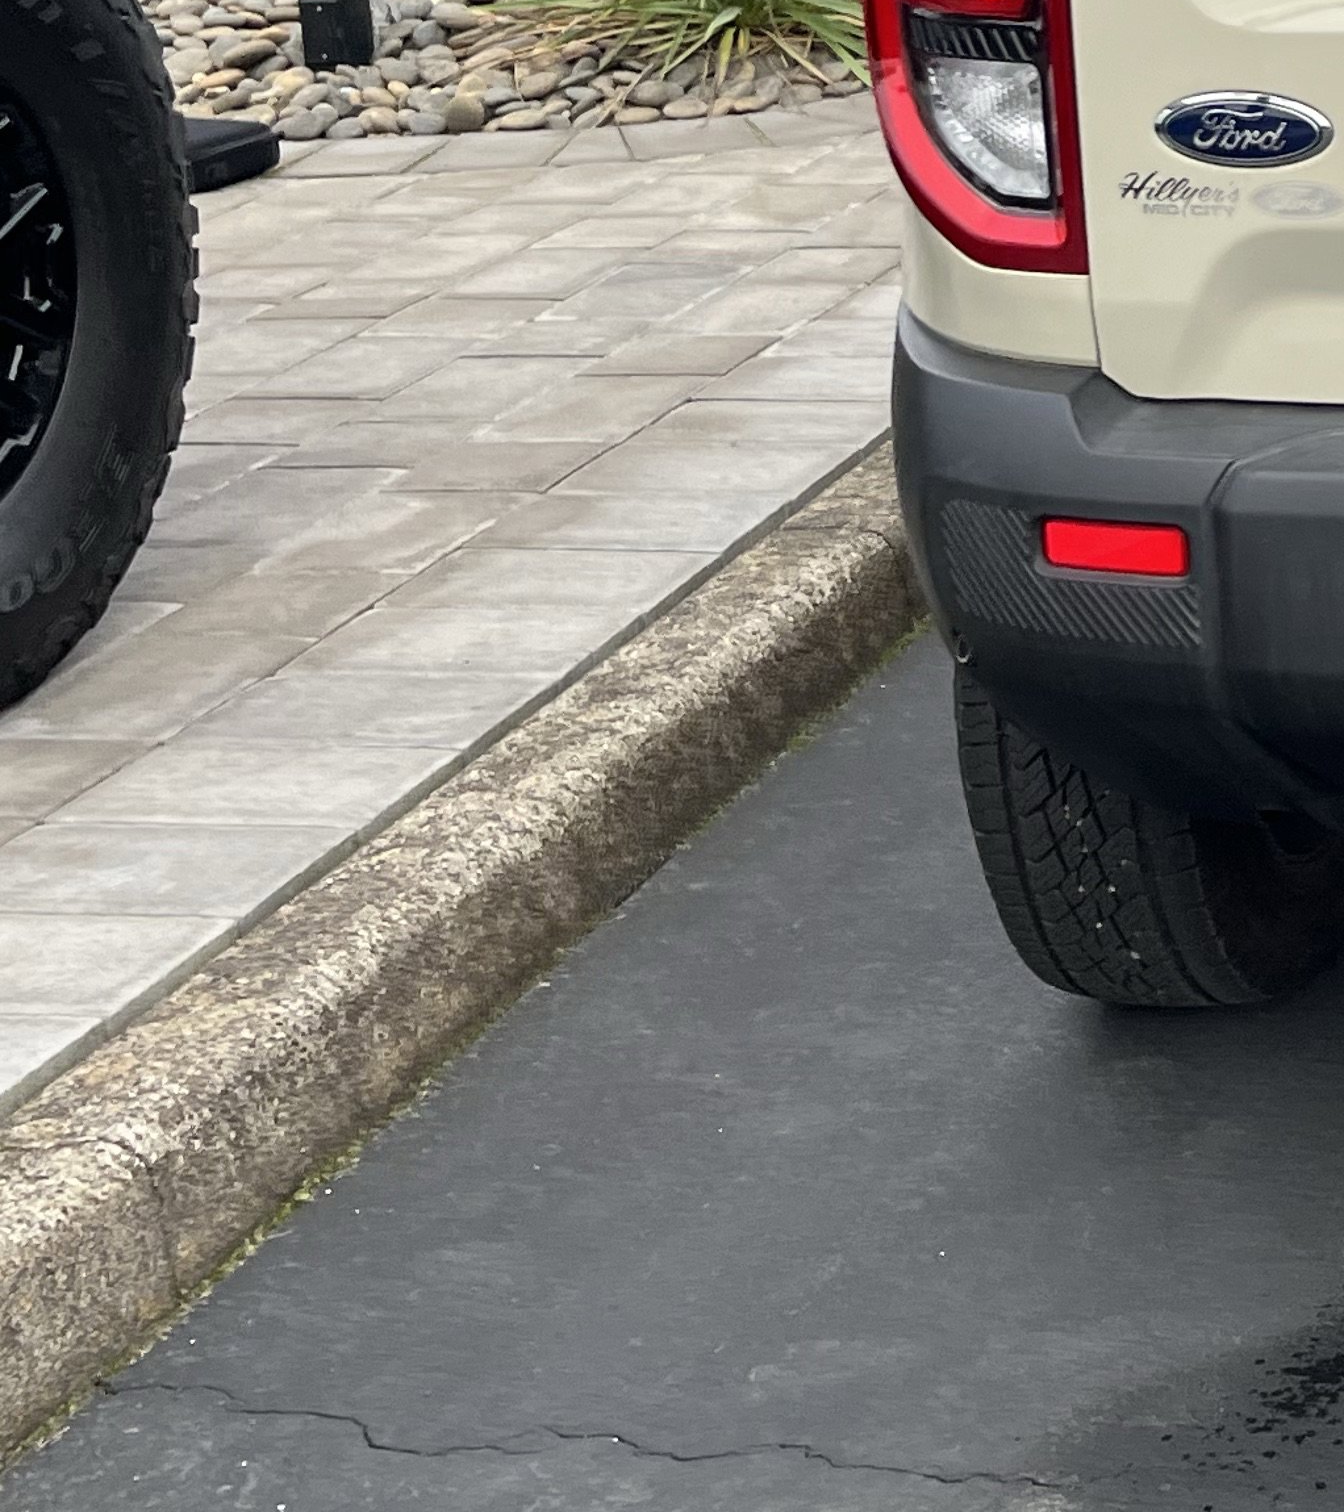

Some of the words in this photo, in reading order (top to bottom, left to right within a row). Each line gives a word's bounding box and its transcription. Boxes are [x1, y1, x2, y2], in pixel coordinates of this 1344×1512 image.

[1192, 108, 1287, 152] Ford
[1119, 170, 1241, 217] Hillyer's
[1190, 205, 1235, 217] CITY
